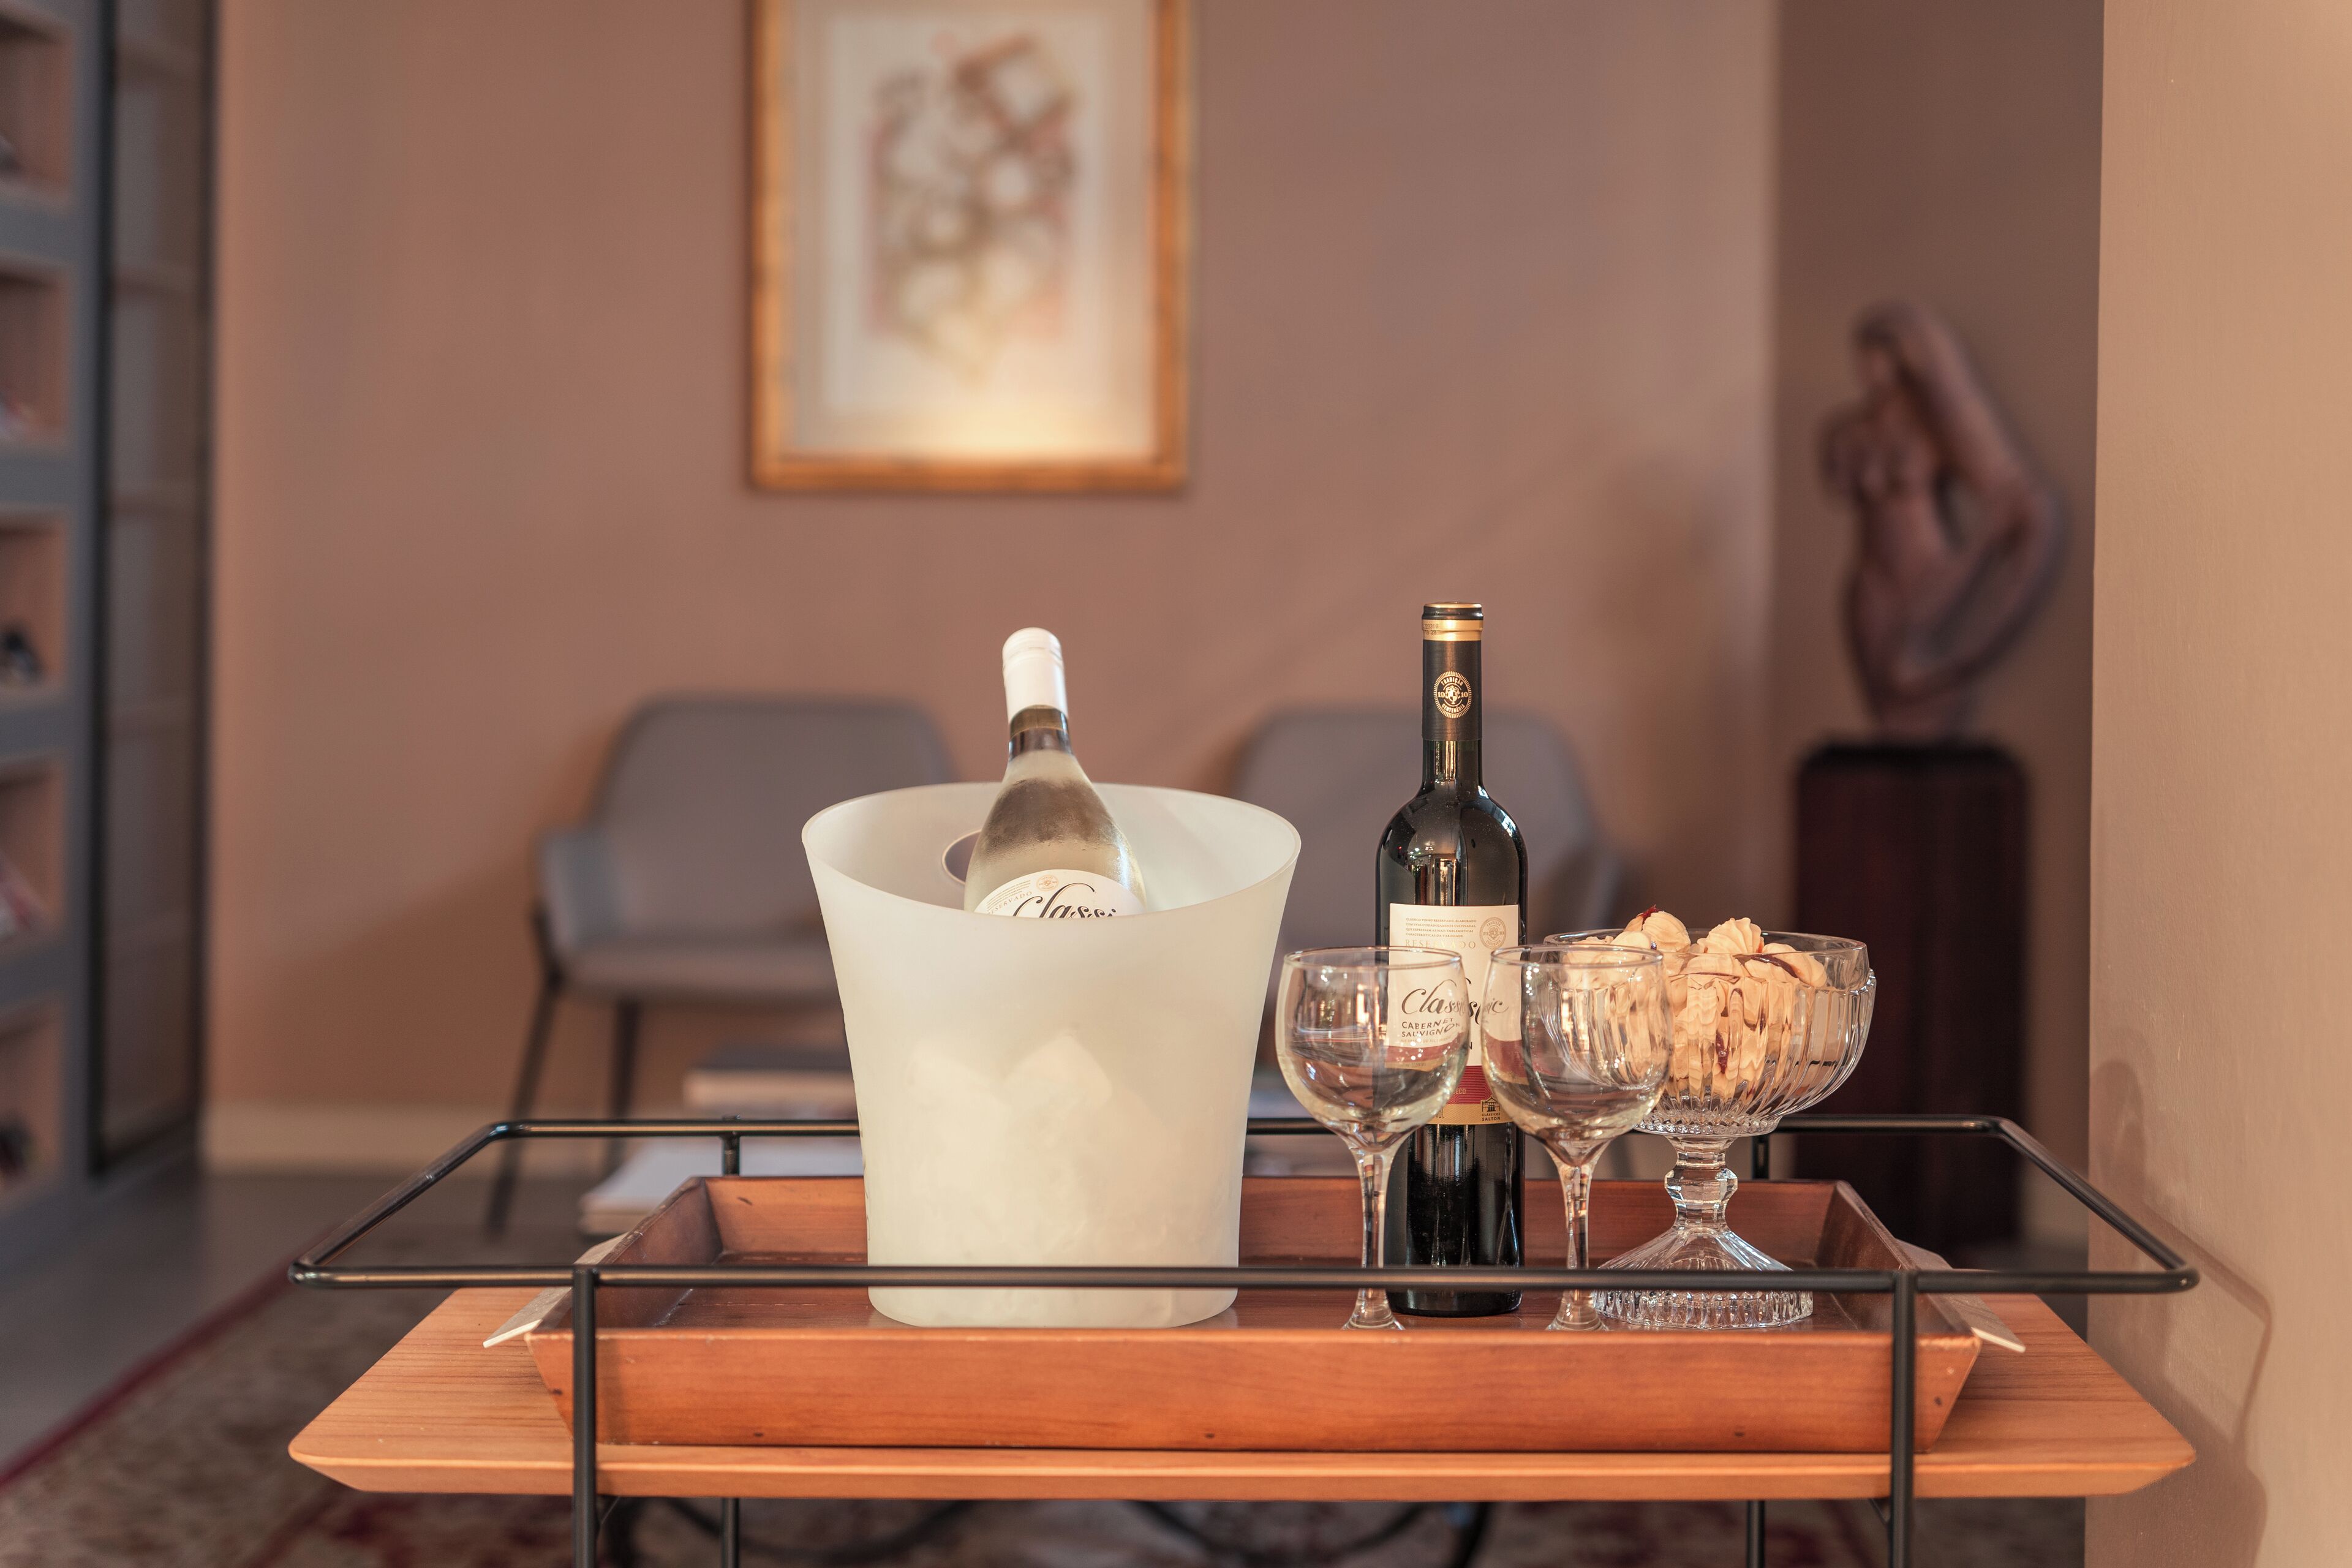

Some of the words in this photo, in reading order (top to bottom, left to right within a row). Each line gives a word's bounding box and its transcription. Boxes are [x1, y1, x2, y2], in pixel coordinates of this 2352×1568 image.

[1441, 677, 1463, 686] TRADIÇÃO
[989, 891, 1033, 914] ESERVADO
[1405, 939, 1476, 949] RESERVADO
[1401, 1017, 1453, 1030] CABERNET
[1401, 1022, 1460, 1038] SAUVIGNON
